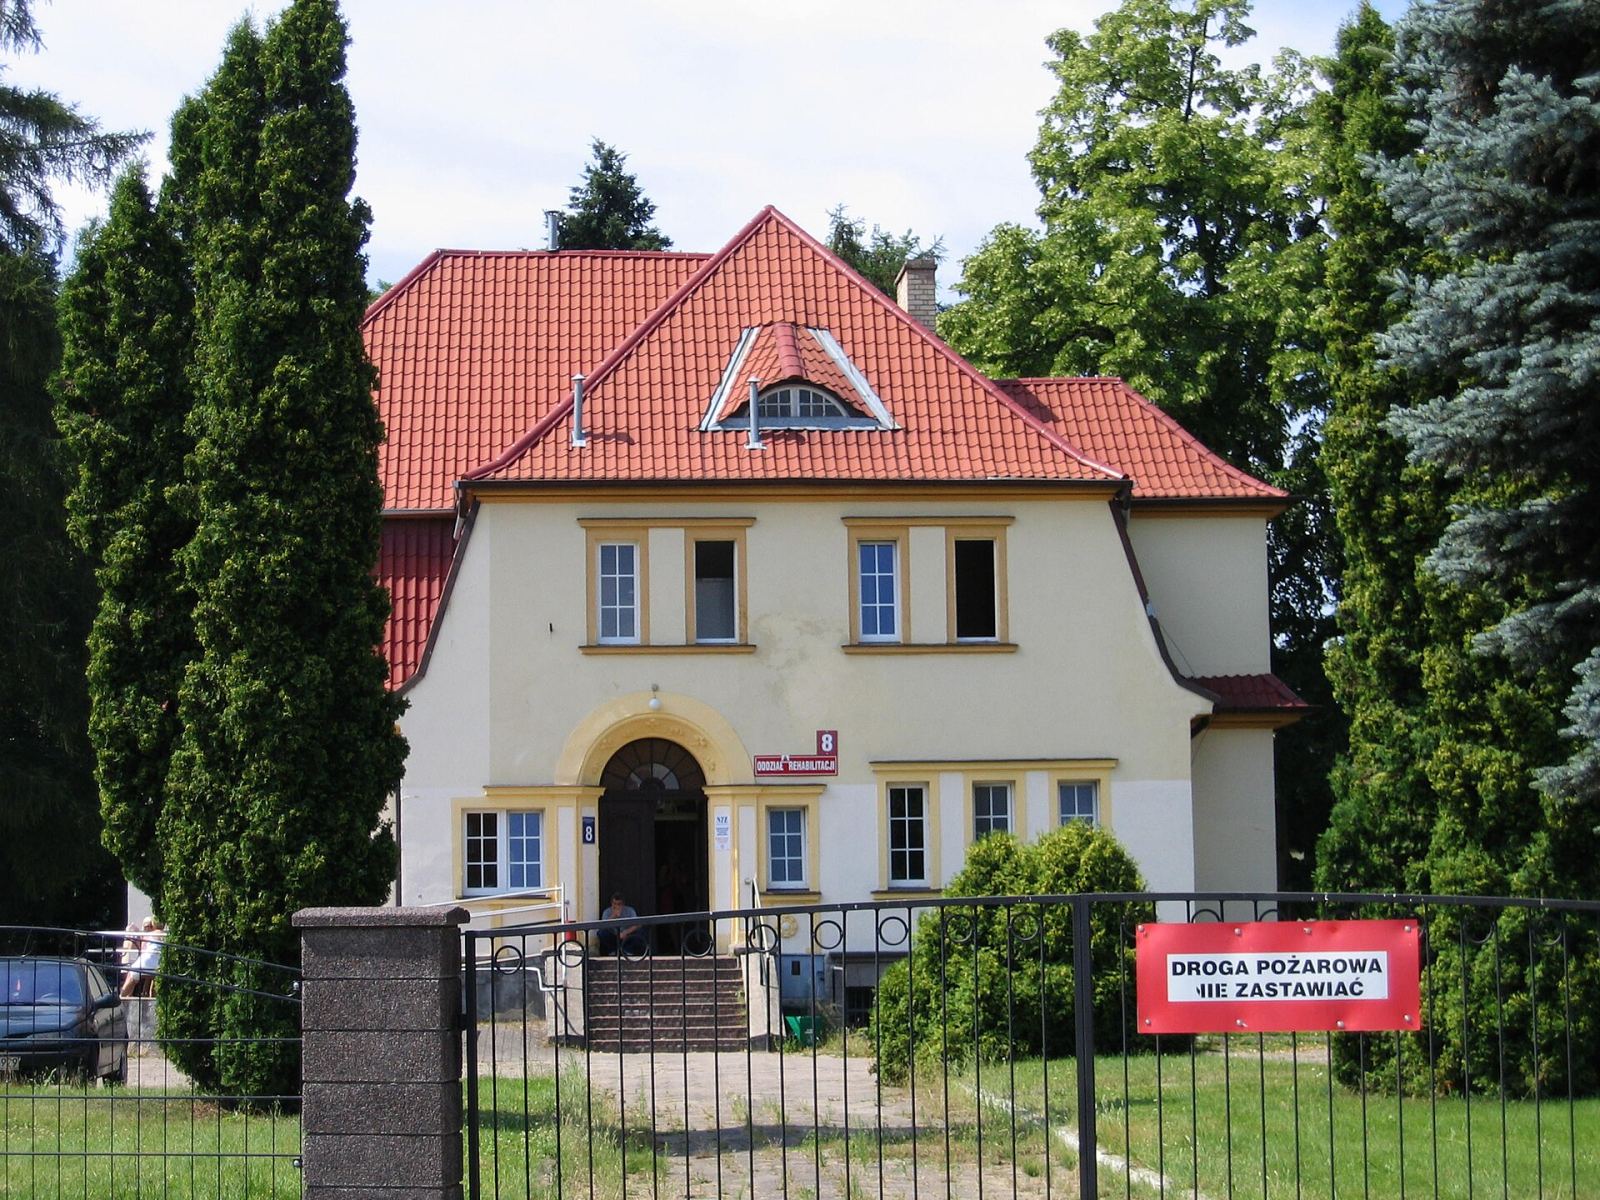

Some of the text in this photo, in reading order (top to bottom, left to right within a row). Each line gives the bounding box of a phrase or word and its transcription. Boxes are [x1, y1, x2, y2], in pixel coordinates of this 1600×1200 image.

[821, 733, 833, 752] 8
[788, 760, 835, 771] REHABILITACJI
[585, 825, 593, 842] 8
[1171, 955, 1382, 976] DROGA POŻAROWA
[1235, 977, 1364, 998] ZASTAWIAĆ
